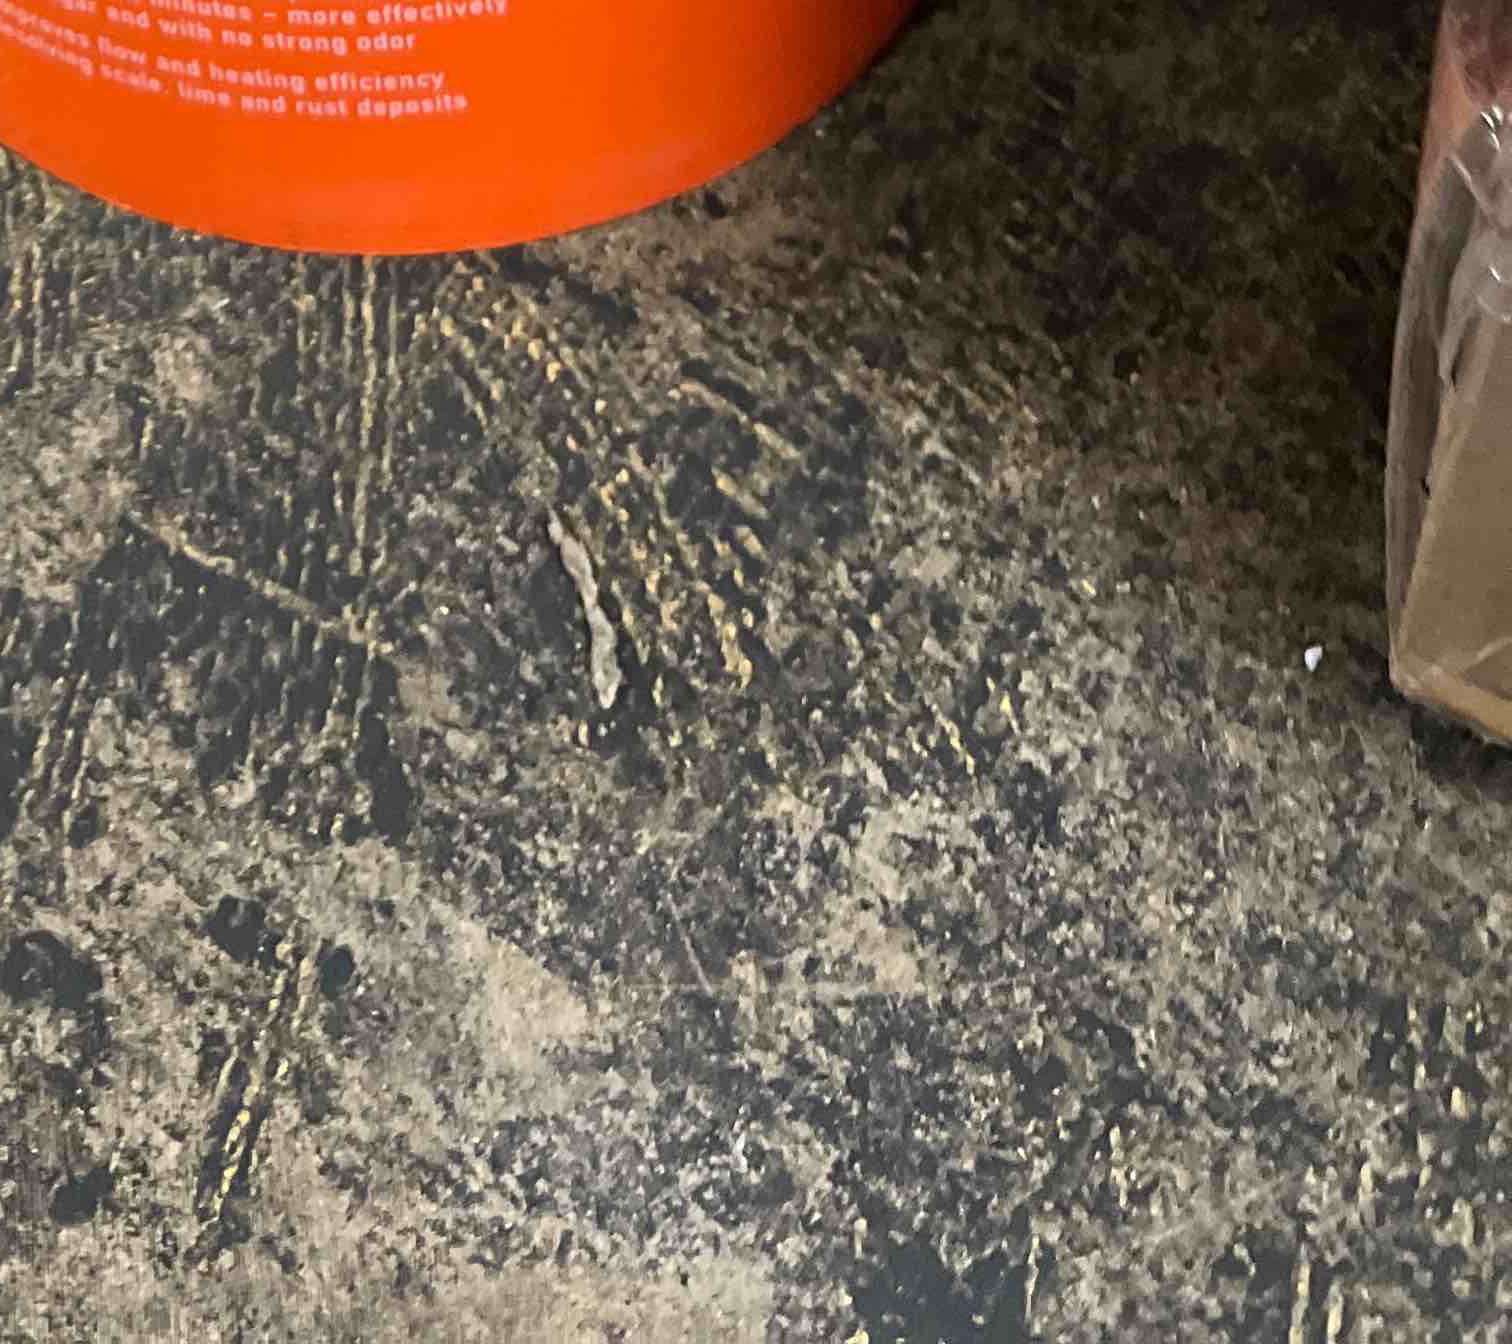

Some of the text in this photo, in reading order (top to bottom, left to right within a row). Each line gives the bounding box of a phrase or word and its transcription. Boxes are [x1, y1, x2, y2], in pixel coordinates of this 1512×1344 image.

[107, 4, 151, 29] and
[158, 16, 213, 42] with
[222, 30, 254, 47] no
[263, 30, 348, 56] strong
[357, 30, 418, 51] odor
[287, 9, 357, 26] more
[157, 56, 201, 79] and
[209, 64, 306, 94] heating
[315, 70, 446, 92] efficiency
[178, 82, 231, 109] lime
[241, 94, 286, 114] and
[296, 98, 348, 117] rust
[357, 93, 469, 119] deposits
